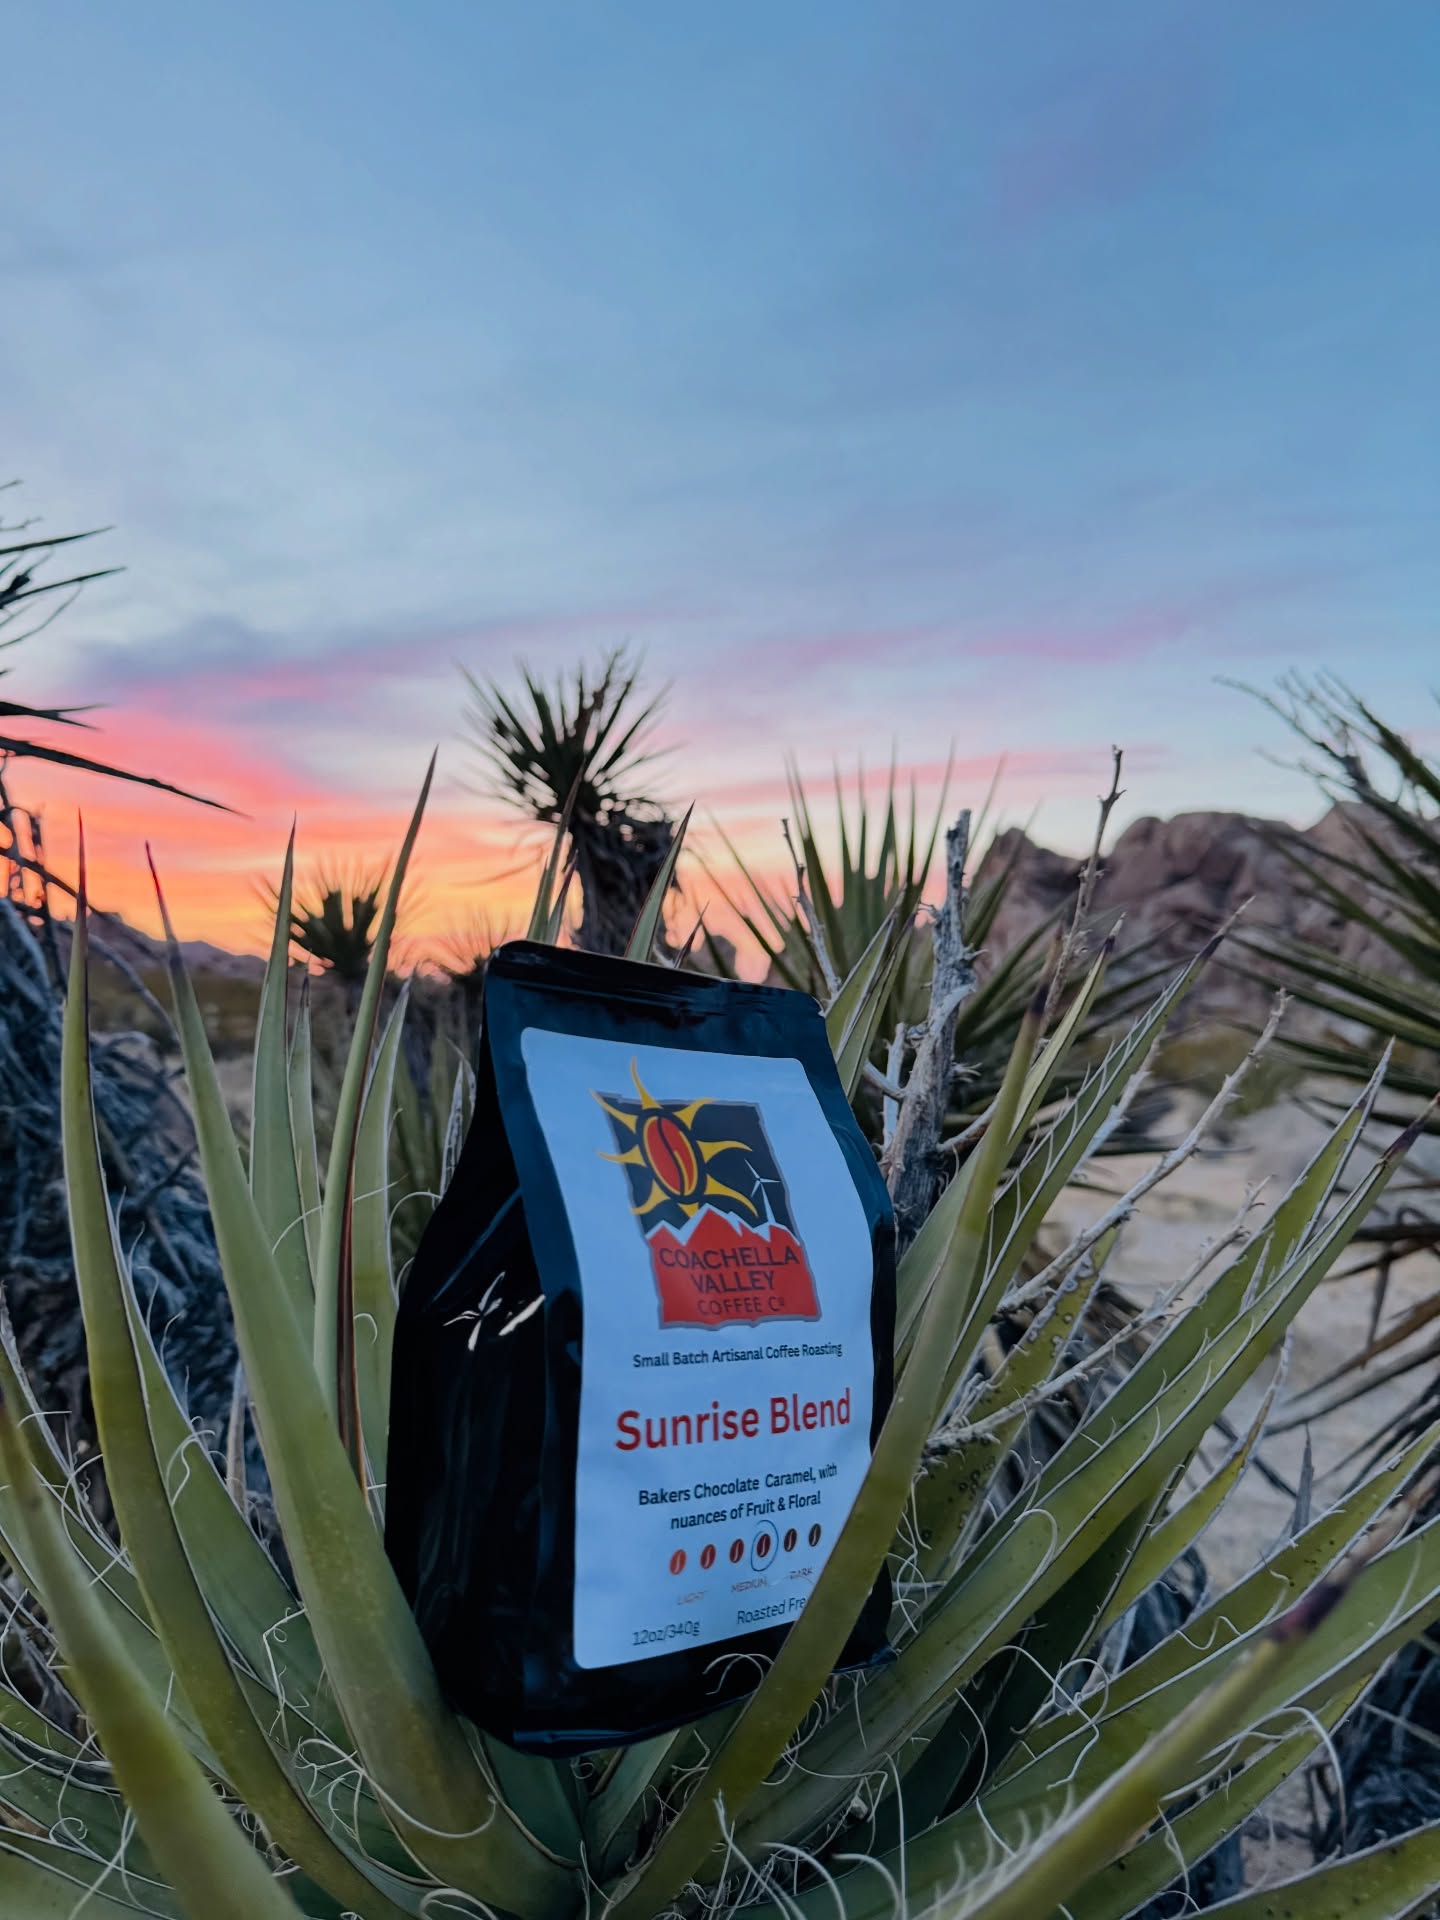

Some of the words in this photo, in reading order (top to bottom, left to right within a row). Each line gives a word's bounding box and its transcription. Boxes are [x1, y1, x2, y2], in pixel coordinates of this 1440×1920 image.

[658, 1246, 800, 1270] COACHELLA
[690, 1270, 775, 1293] VALLEY
[697, 1297, 761, 1316] COFFEE
[633, 1351, 670, 1368] Small
[673, 1349, 709, 1365] Batch
[712, 1347, 764, 1363] Artisanal
[766, 1344, 800, 1359] Coffee
[802, 1341, 843, 1358] Roasting
[615, 1400, 759, 1451] Sunrise
[769, 1387, 851, 1434] Blend
[639, 1488, 691, 1506] Bakers
[693, 1477, 760, 1500] Chocolate
[765, 1467, 816, 1489] Caramel,
[819, 1462, 838, 1480] with
[670, 1508, 727, 1530] nuances
[730, 1502, 744, 1520] of
[746, 1499, 775, 1517] Fruit
[778, 1496, 787, 1512] &
[788, 1490, 821, 1510] Floral
[737, 1599, 785, 1625] Roasted
[631, 1620, 700, 1646] 12oz/340g
